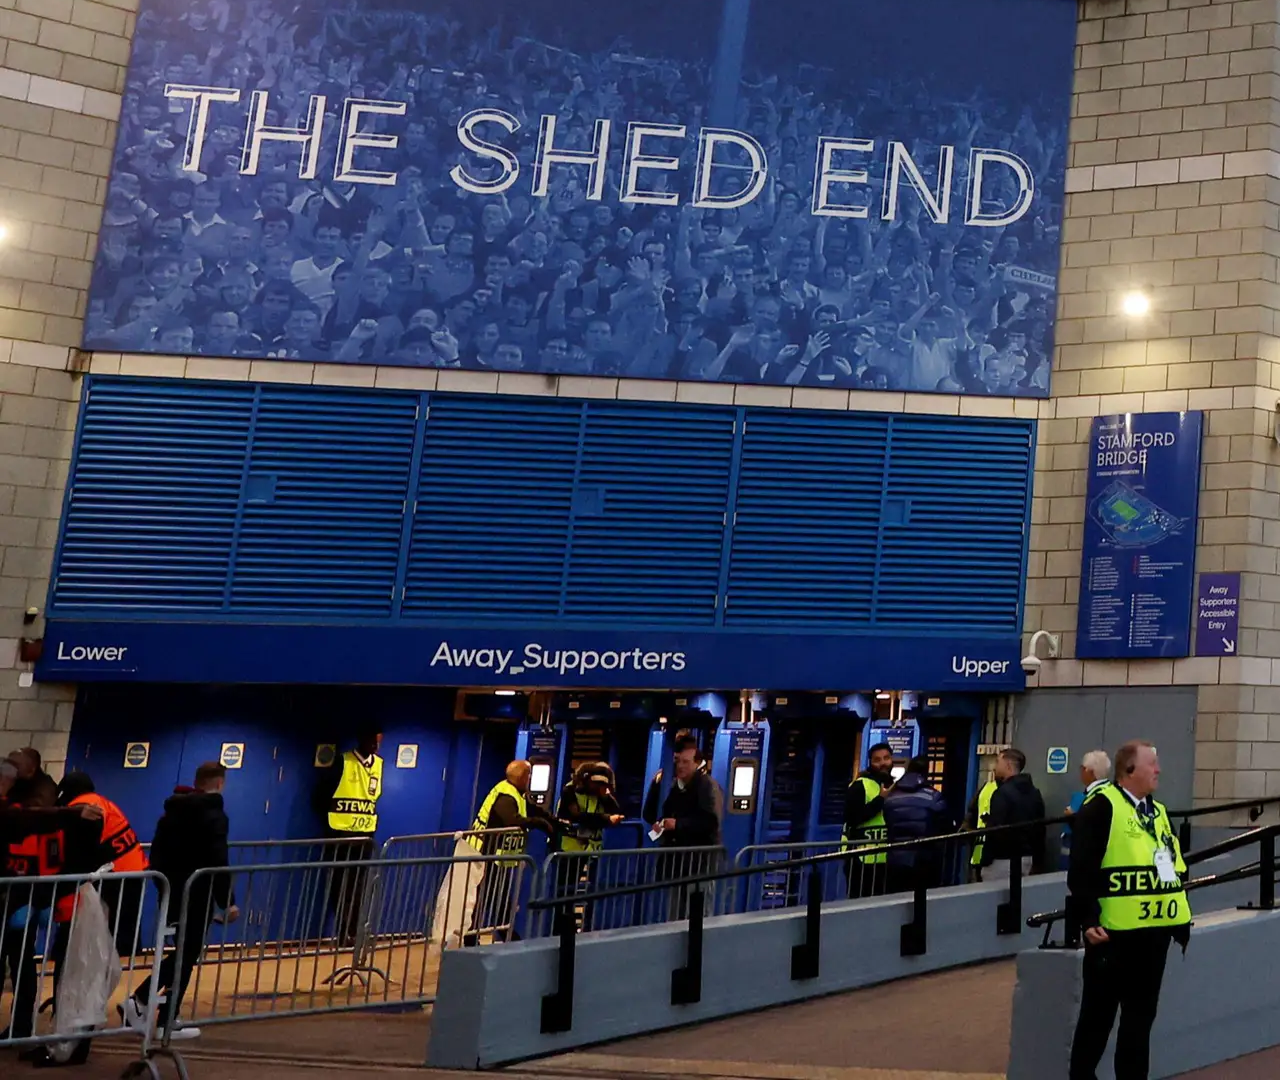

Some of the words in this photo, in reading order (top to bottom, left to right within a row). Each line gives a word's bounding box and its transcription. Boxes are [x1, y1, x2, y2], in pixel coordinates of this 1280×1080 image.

[164, 83, 407, 186] THE
[450, 108, 769, 209] SHED
[811, 136, 1035, 226] END
[1098, 432, 1175, 450] STAMFORD
[1096, 449, 1147, 467] BRIDGE
[1209, 586, 1228, 595] Away
[1200, 597, 1237, 607] Supporters
[1200, 609, 1235, 617] Accessible
[1208, 620, 1226, 630] Entry
[58, 641, 128, 660] Lower
[430, 642, 513, 674] Away
[522, 643, 686, 674] Supporters
[952, 655, 1010, 677] Upper
[1138, 899, 1178, 920] 310
